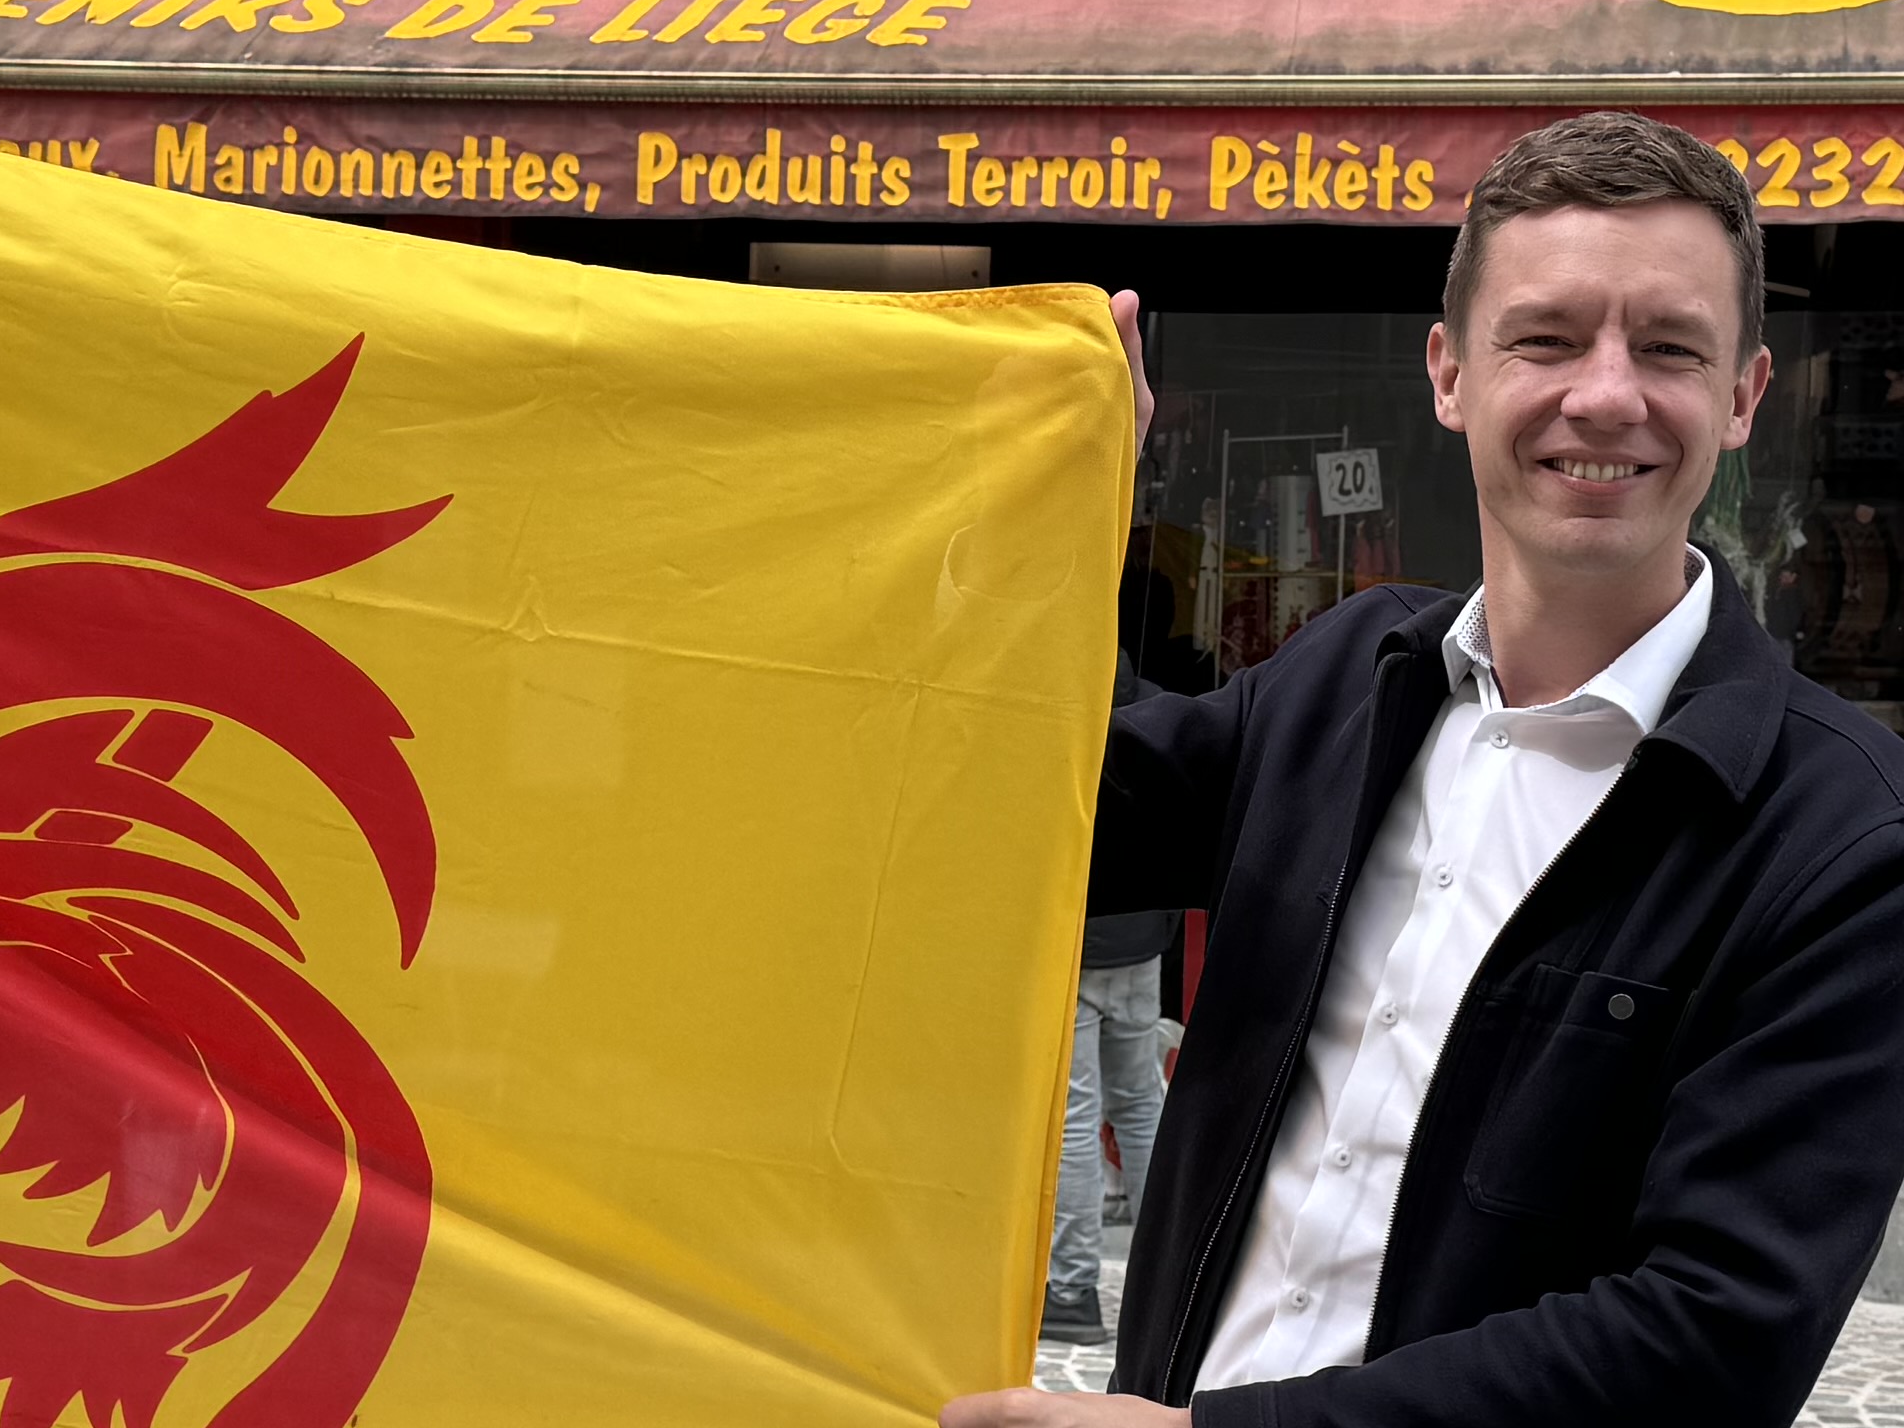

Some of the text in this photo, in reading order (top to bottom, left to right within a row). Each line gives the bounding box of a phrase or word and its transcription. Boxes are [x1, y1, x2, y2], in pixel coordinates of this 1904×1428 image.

[153, 121, 602, 214] Marionnettes,
[636, 127, 913, 207] Produits
[937, 132, 1173, 221] Terroir,
[1209, 132, 1436, 212] Pèkèts
